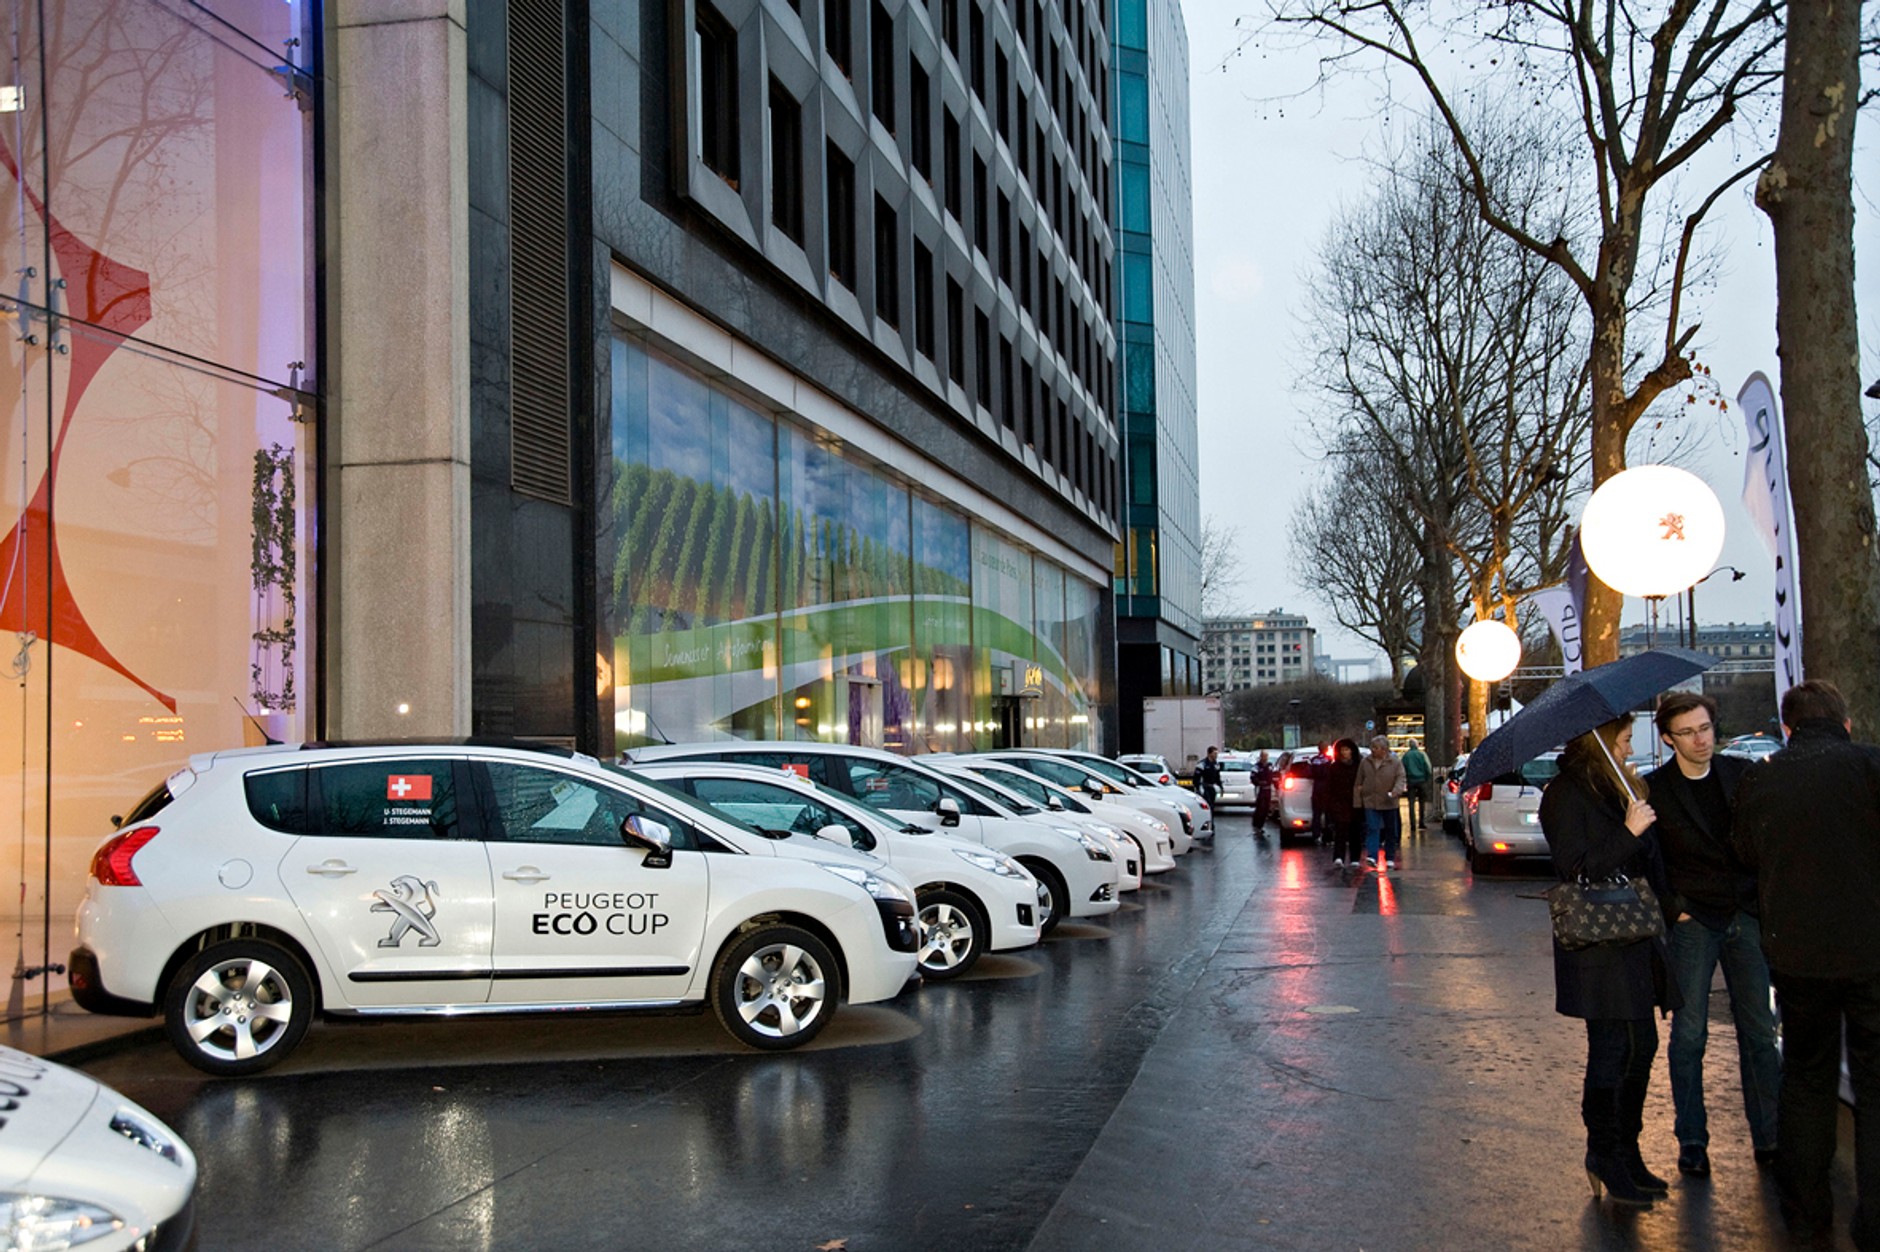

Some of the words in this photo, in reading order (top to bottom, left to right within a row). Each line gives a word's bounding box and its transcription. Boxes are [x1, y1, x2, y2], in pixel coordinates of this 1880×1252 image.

[1562, 604, 1581, 662] CUP
[544, 893, 659, 909] PEUGEOT
[532, 911, 598, 935] ECO
[606, 913, 669, 935] CUP
